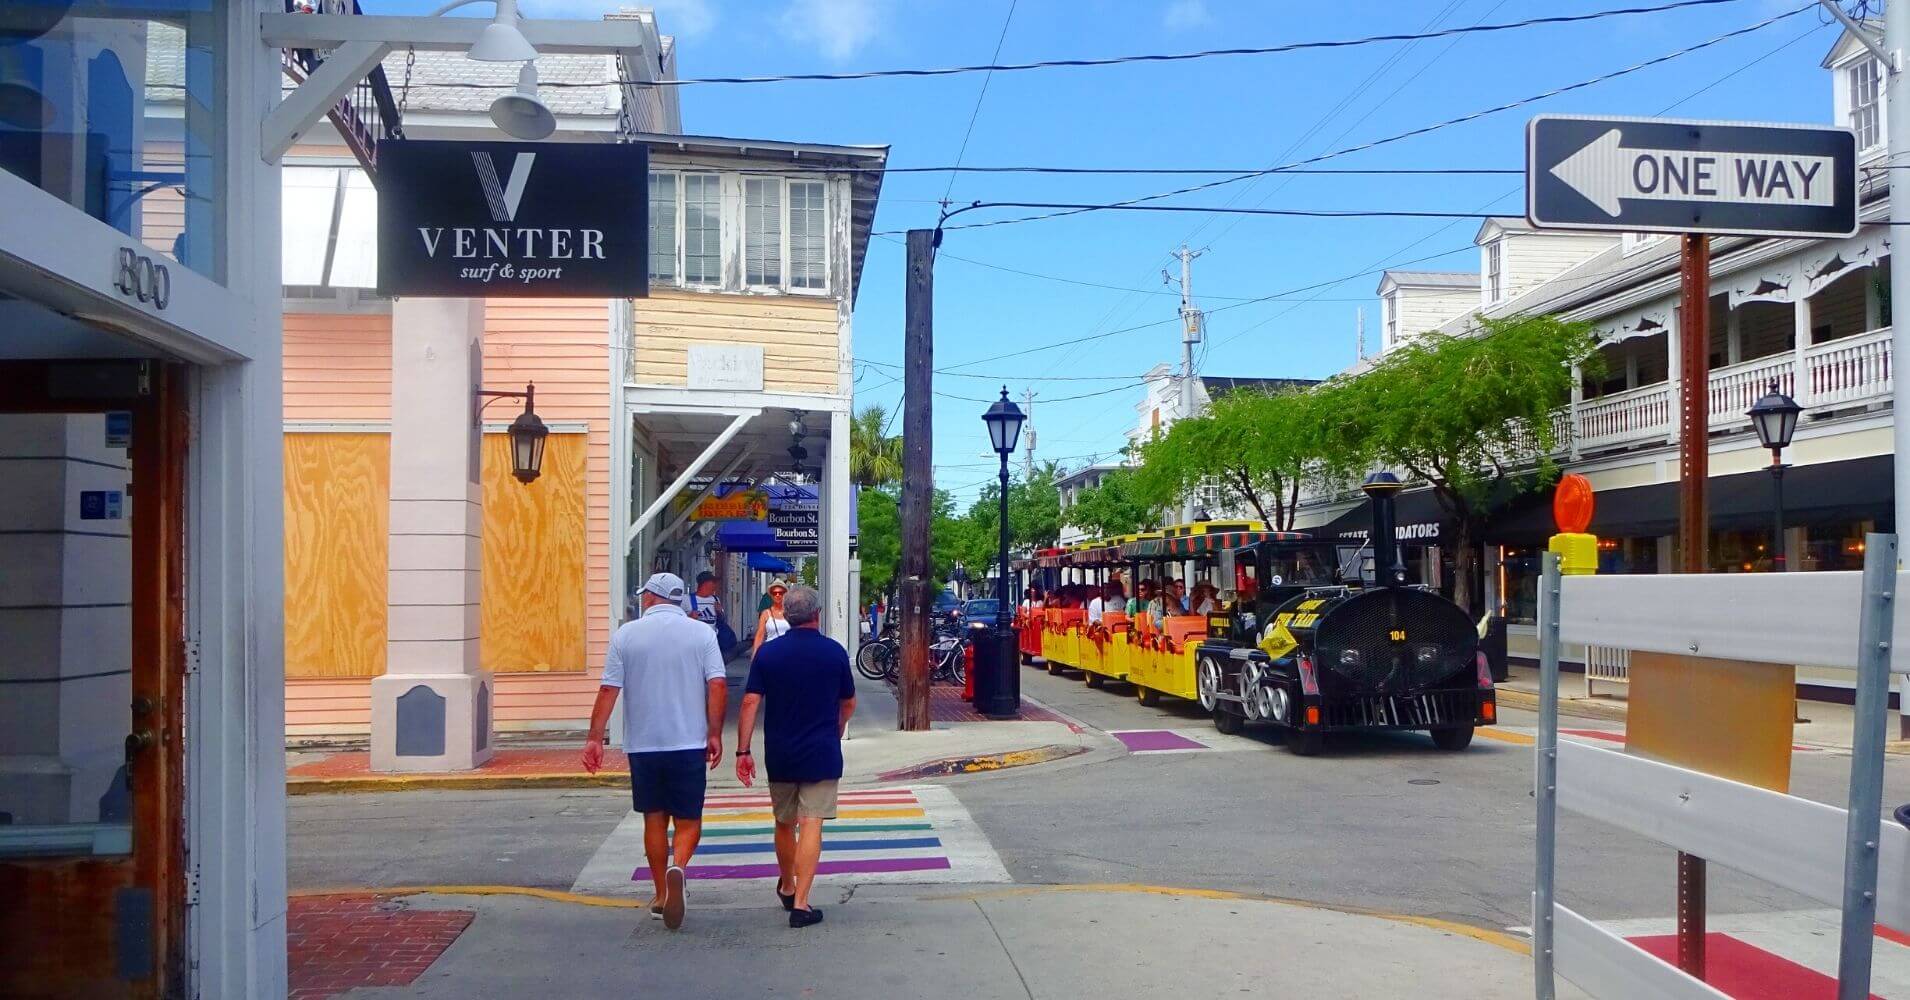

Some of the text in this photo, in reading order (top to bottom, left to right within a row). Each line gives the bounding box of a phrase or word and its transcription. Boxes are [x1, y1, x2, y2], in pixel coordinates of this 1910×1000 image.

[1632, 153, 1823, 201] ONE WAY
[417, 227, 607, 260] VENTER
[118, 246, 171, 311] 800
[460, 262, 563, 284] surf & sport
[769, 513, 818, 524] Bourbon St.
[776, 528, 818, 538] Bourbon St.
[1389, 630, 1405, 640] 104
